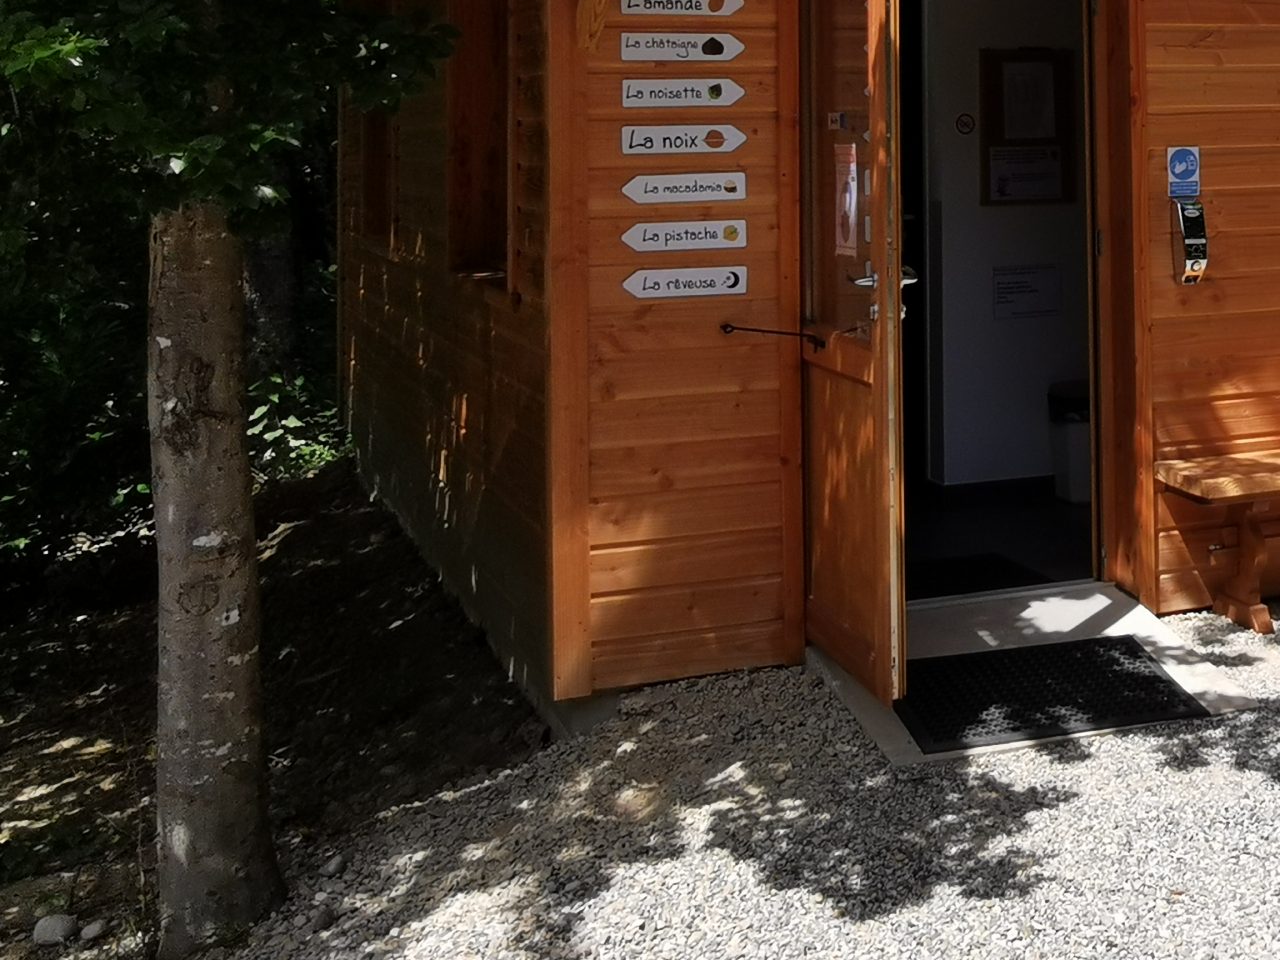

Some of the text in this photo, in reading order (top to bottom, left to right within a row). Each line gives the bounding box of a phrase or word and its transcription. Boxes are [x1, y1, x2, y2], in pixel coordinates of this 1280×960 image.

[625, 37, 641, 49] La
[626, 85, 702, 100] La noisette
[629, 129, 699, 150] La noix
[644, 180, 722, 195] La macadamia
[642, 227, 719, 247] La pistache
[642, 277, 717, 291] La rêveuse
